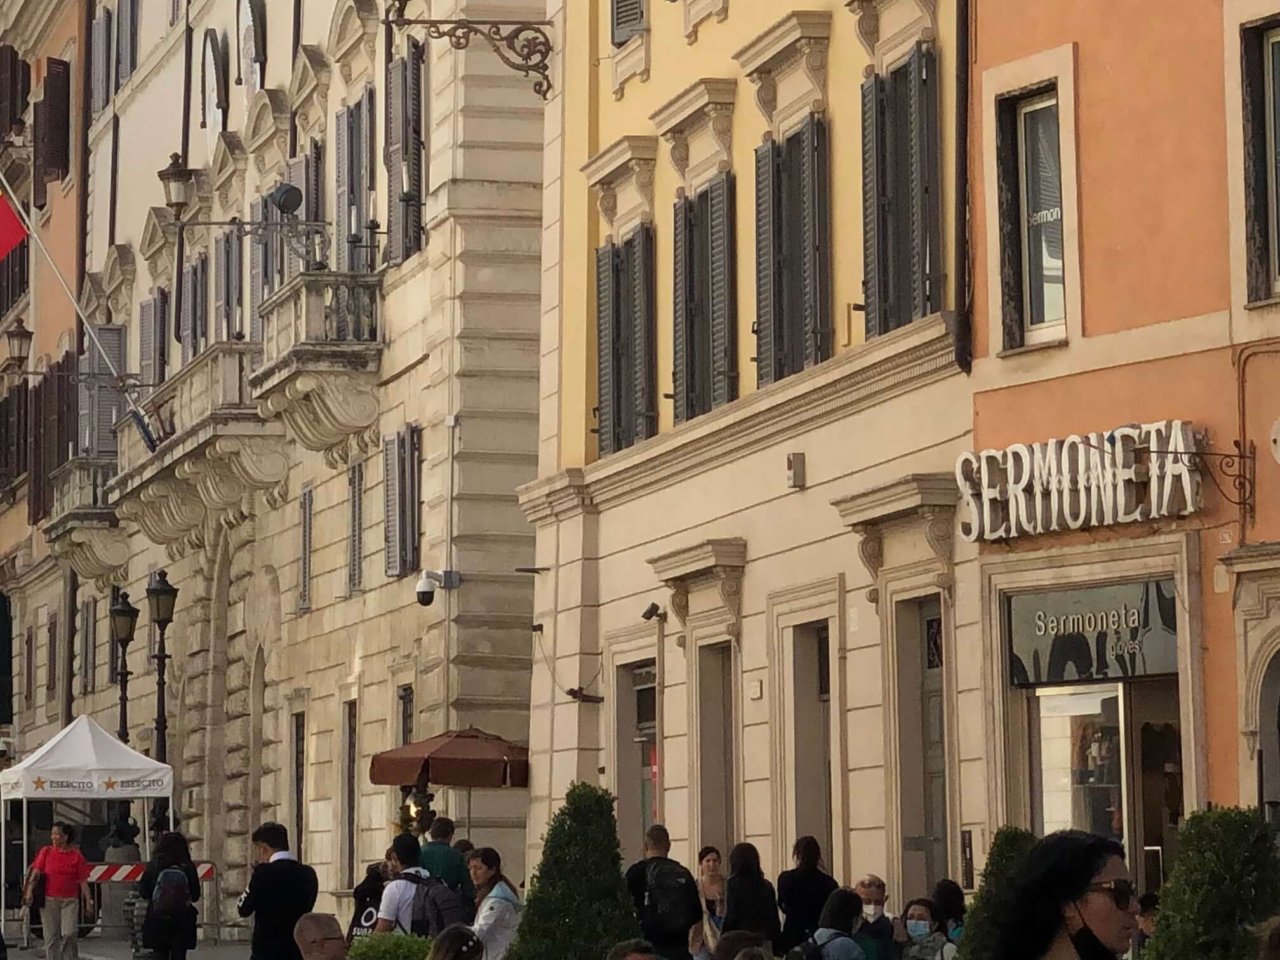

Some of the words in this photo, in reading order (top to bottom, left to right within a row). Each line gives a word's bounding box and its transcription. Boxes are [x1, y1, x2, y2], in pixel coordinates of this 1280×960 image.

[955, 420, 1197, 542] SERMONETA
[1035, 603, 1140, 636] Sermoneta
[49, 780, 94, 790] ESERCITO
[120, 778, 165, 789] ESERCITO
